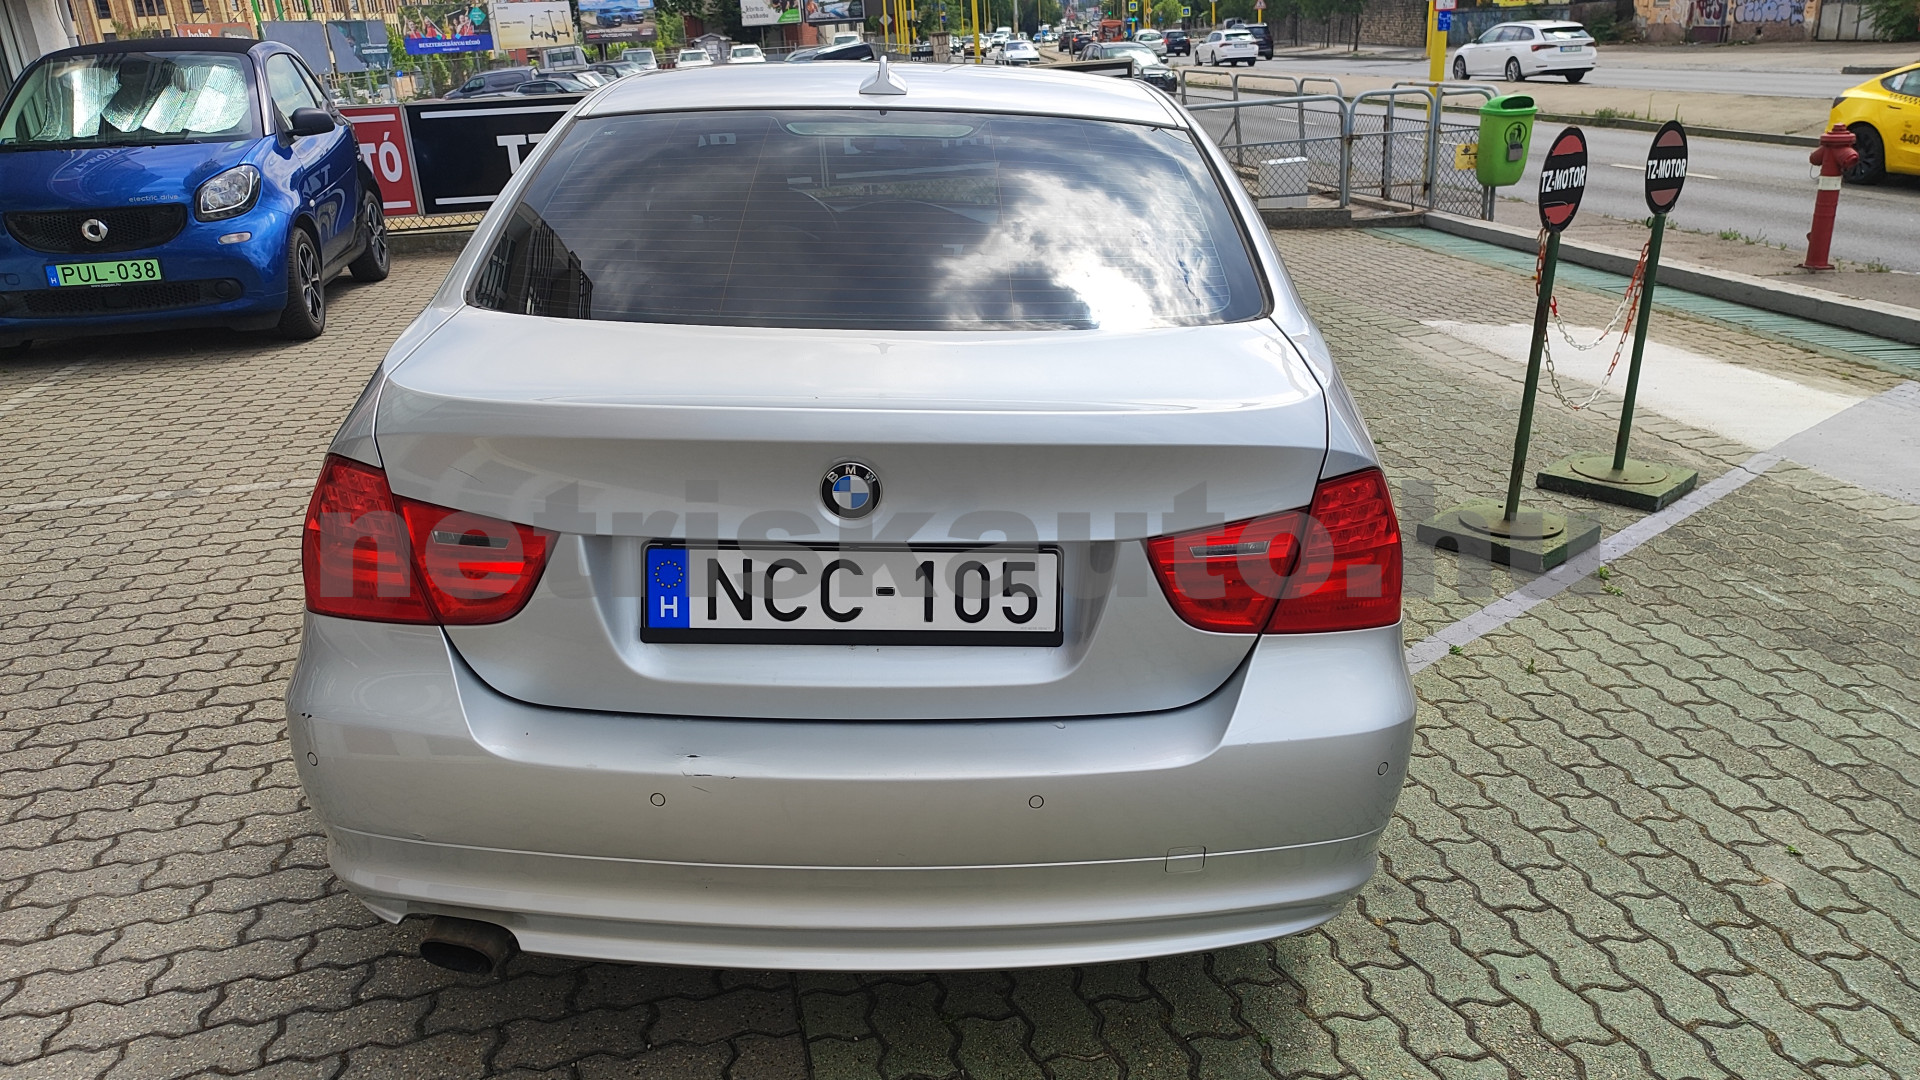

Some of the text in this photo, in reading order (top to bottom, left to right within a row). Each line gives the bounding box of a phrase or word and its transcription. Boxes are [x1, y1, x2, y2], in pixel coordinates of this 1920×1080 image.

[497, 133, 545, 174] T
[1541, 165, 1586, 193] TZ-MOTOR
[1648, 158, 1687, 179] TZ-MOTOR
[128, 195, 157, 203] electric
[61, 261, 156, 284] PUL-038
[826, 465, 877, 484] BMW
[660, 558, 1038, 624] H NCC-105
